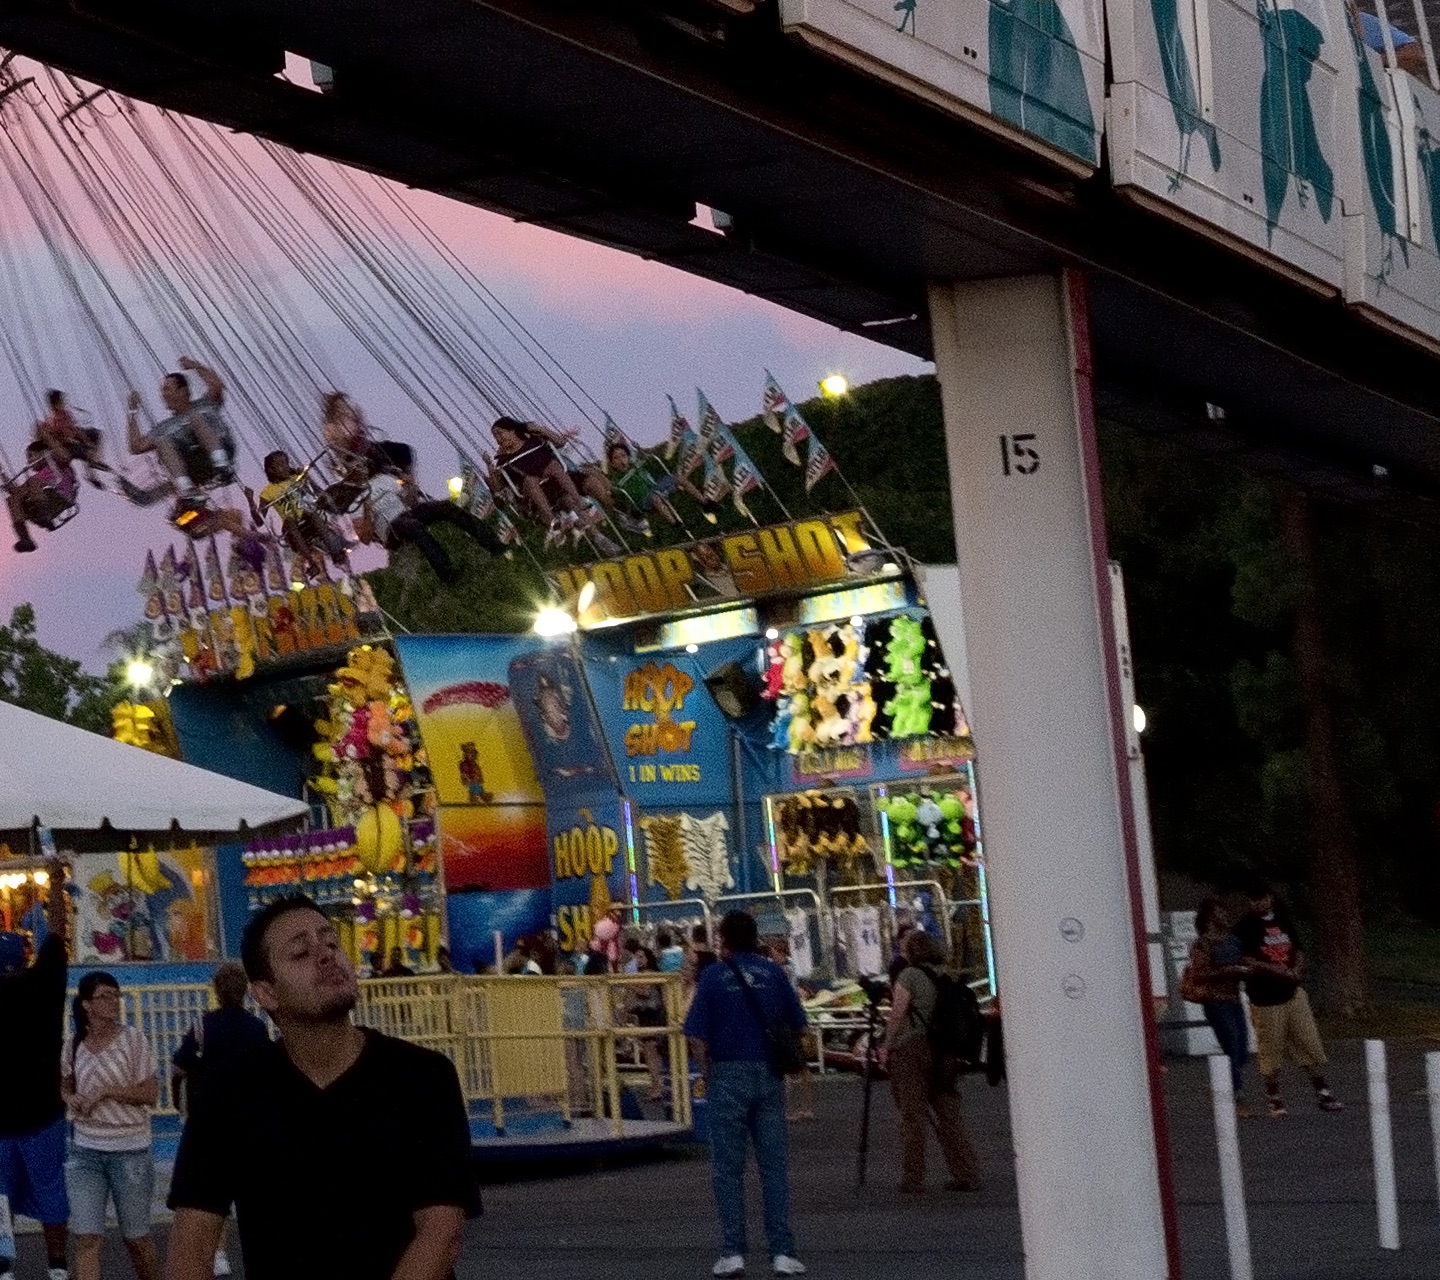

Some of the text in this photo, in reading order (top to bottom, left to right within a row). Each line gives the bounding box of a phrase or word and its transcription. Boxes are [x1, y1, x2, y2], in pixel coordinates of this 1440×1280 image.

[999, 433, 1042, 477] 15
[722, 510, 872, 596] SHOT
[640, 765, 657, 782] IN
[662, 764, 701, 782] WINS
[553, 823, 619, 879] HOOP
